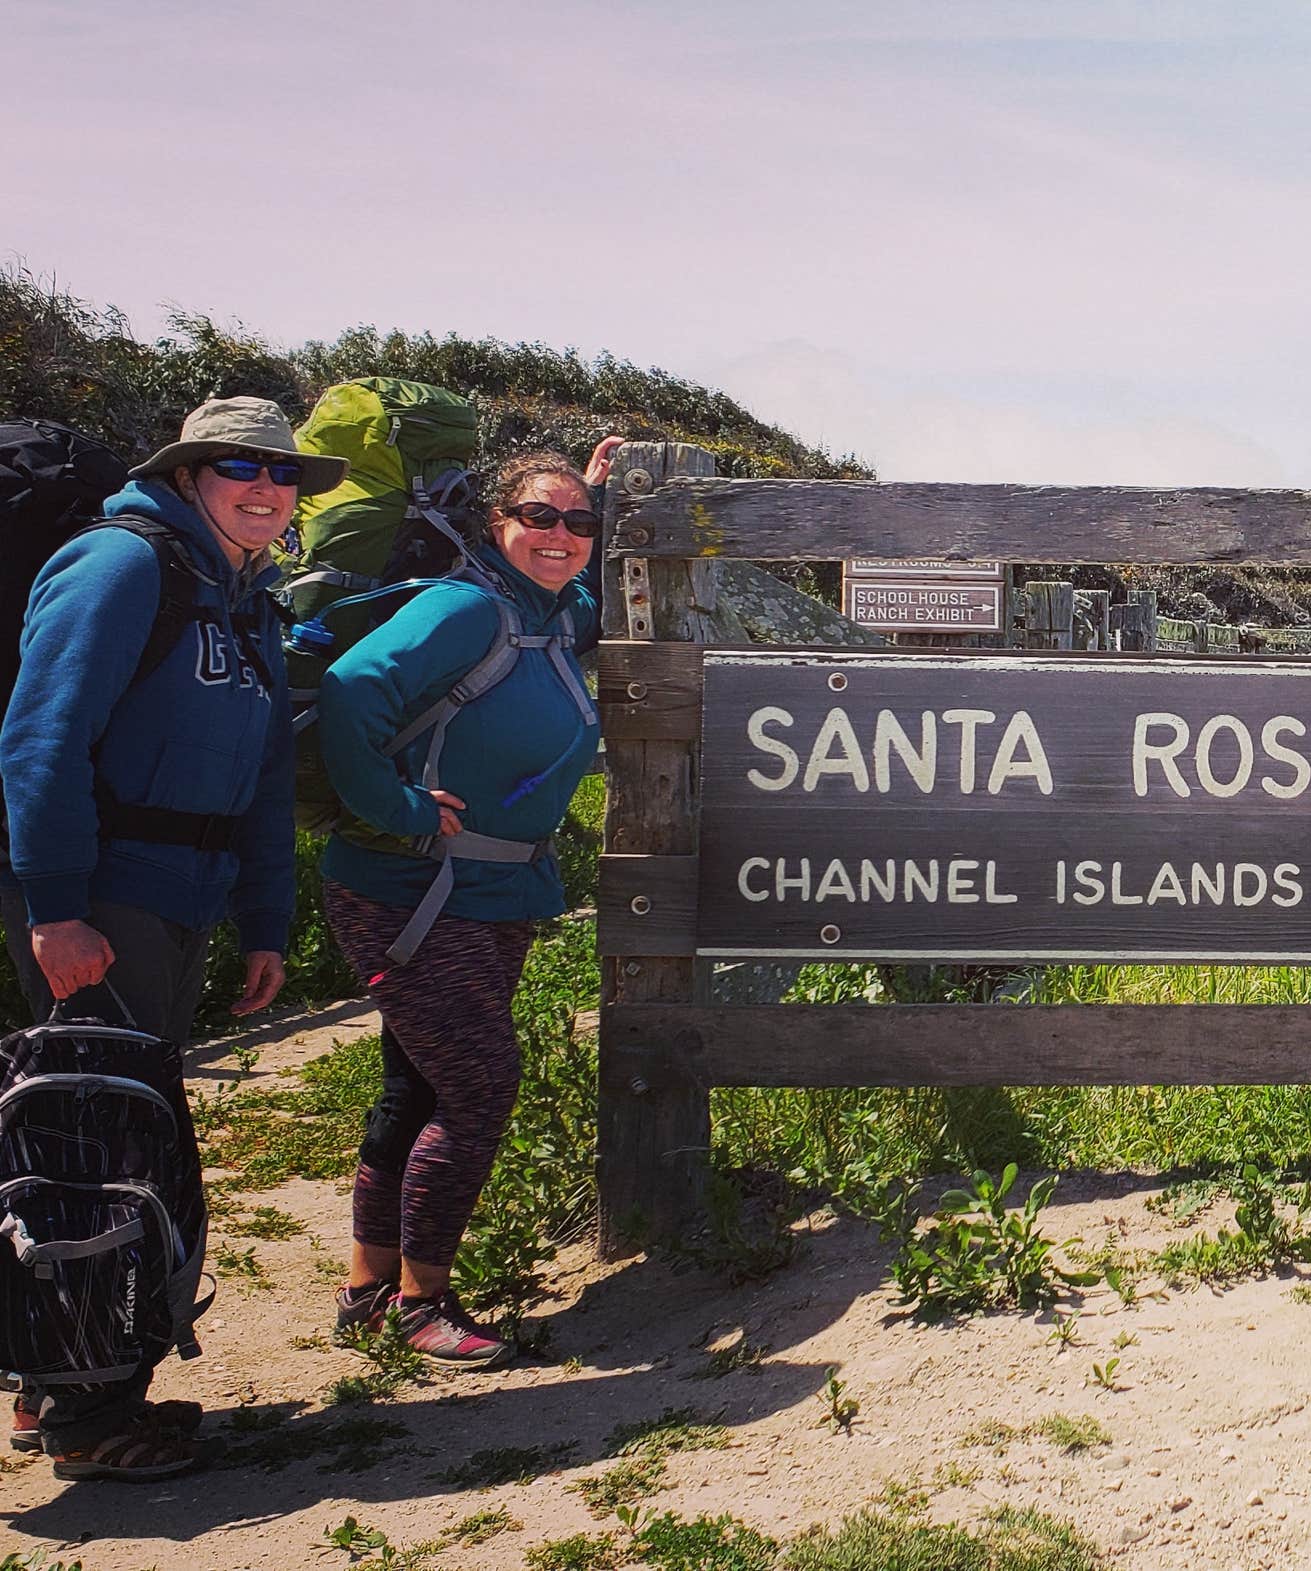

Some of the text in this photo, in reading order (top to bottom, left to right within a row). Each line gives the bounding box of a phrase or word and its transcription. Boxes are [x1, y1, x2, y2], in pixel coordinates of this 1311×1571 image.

[857, 591, 969, 605] SCHOOLHOUSE
[857, 607, 974, 621] RANCH EXHIBIT
[747, 706, 1054, 796] SANTA
[738, 857, 1018, 904] CHANNEL
[1056, 860, 1303, 908] ISLANDS
